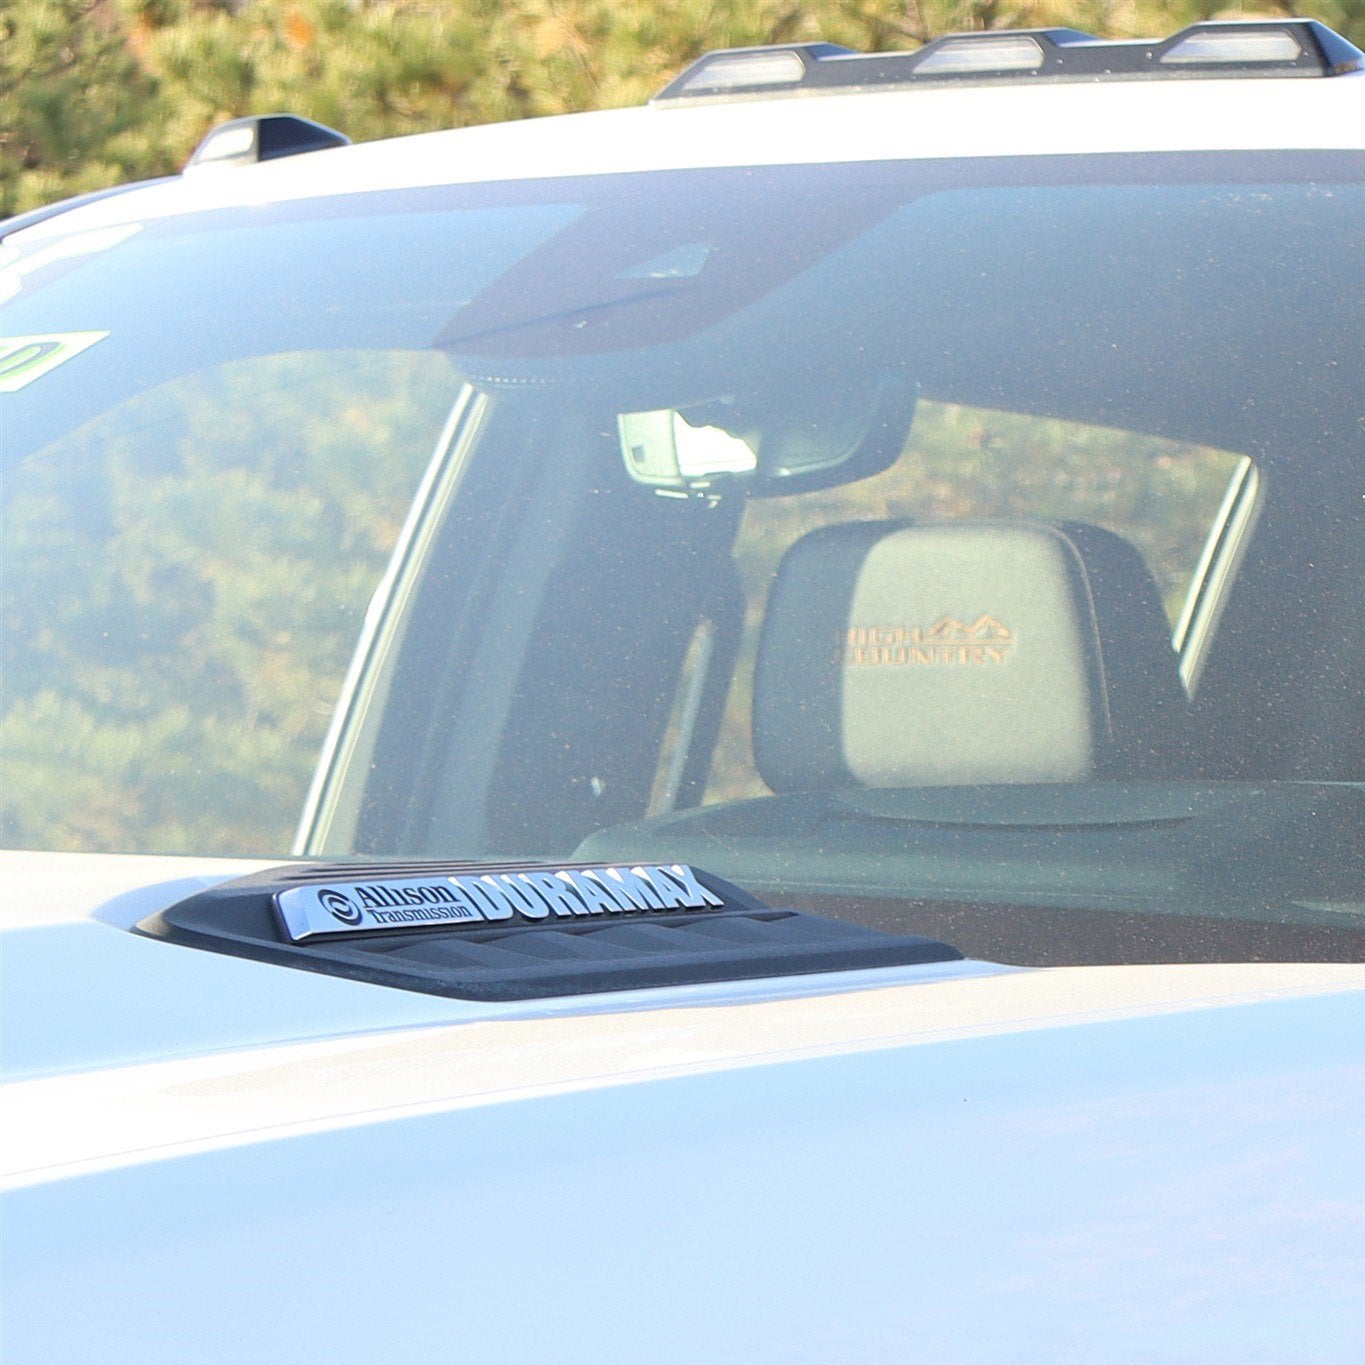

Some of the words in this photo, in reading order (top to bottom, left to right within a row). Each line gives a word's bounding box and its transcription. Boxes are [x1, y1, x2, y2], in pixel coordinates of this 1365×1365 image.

[354, 885, 461, 909] Allison
[448, 864, 725, 921] DURAMAX
[366, 905, 474, 924] Transmission
